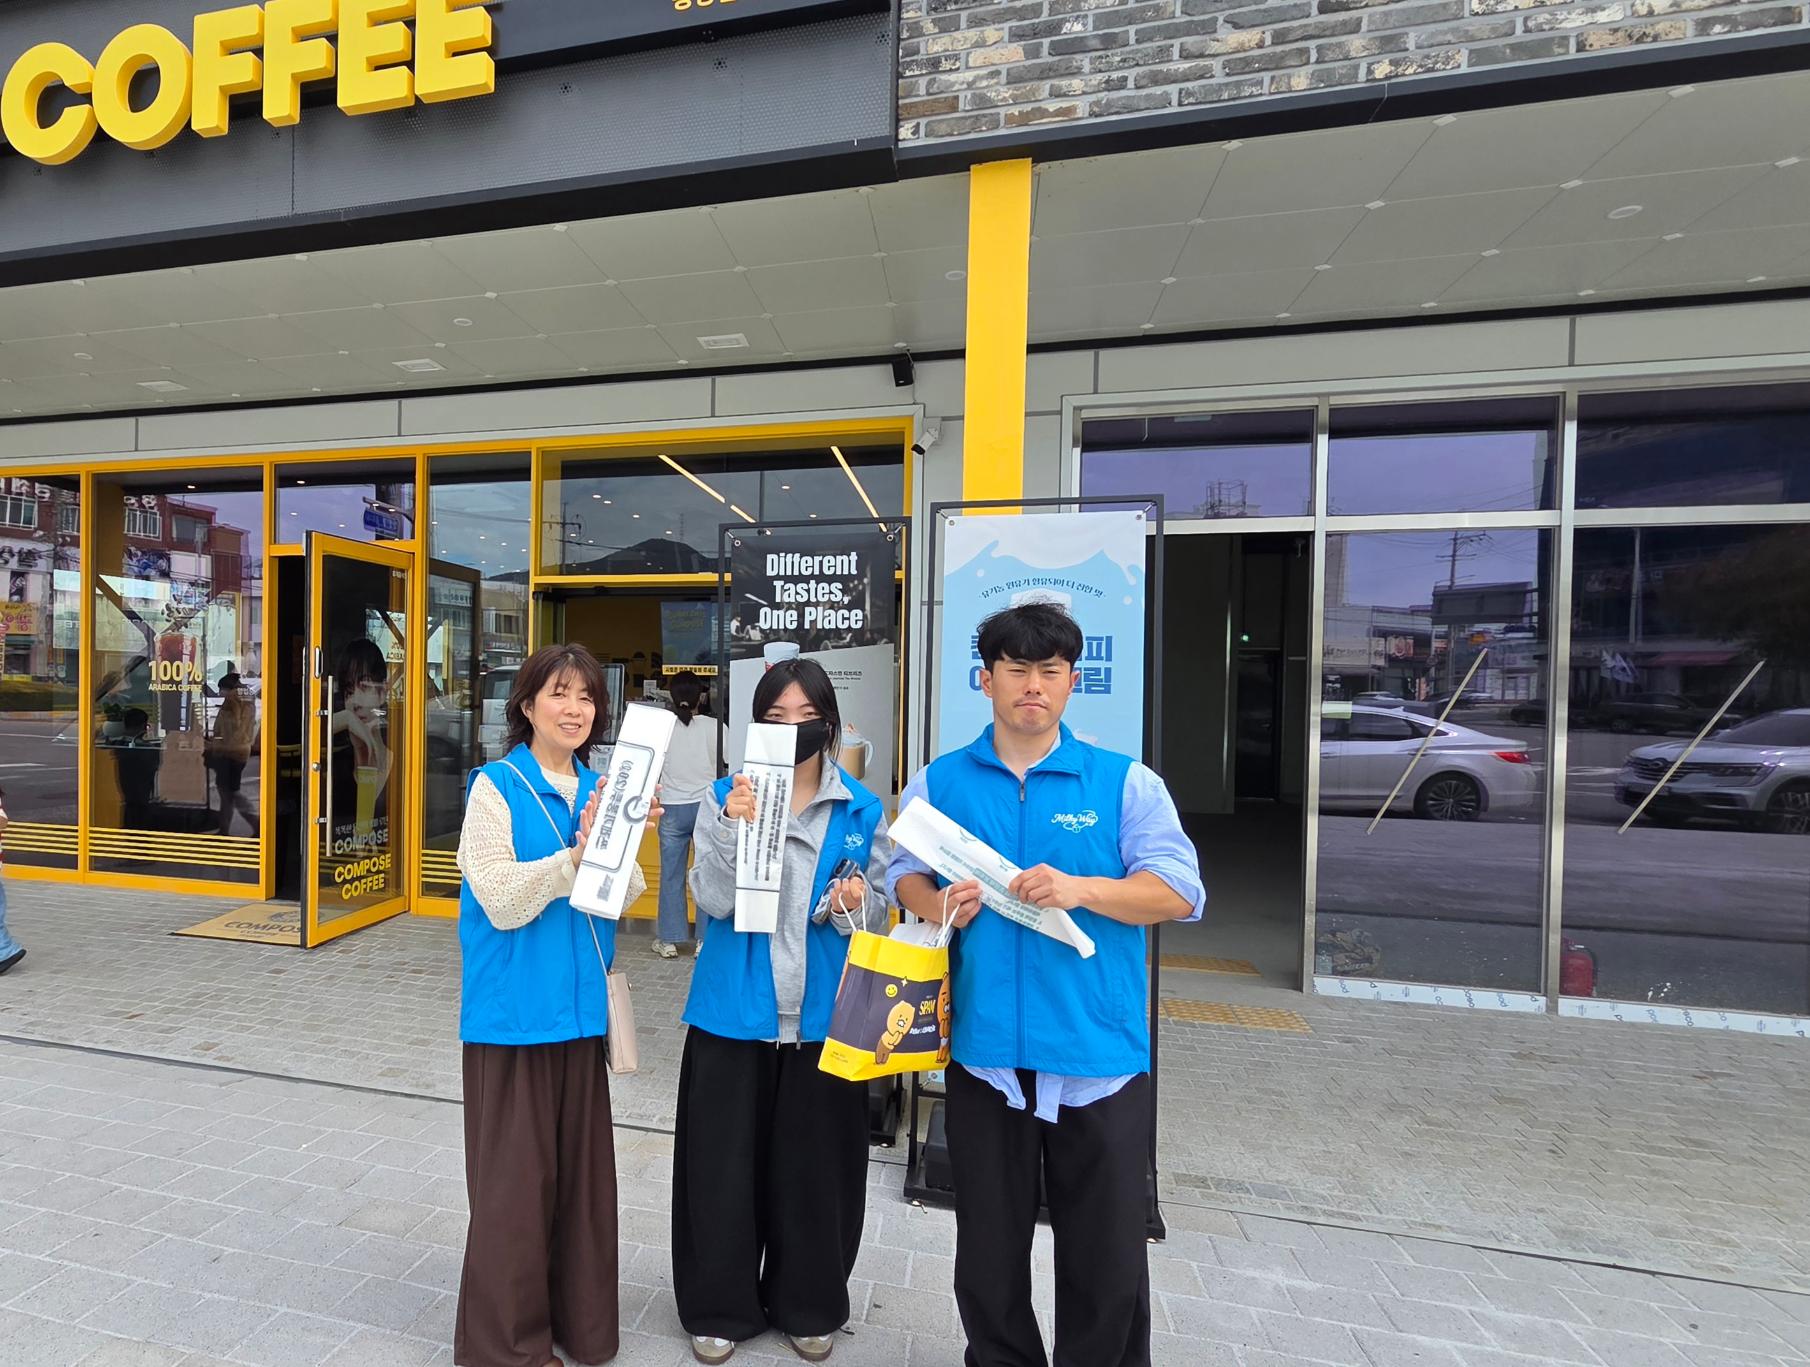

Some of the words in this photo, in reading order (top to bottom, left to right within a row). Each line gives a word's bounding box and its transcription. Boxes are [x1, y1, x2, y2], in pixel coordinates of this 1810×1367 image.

[1, 0, 496, 165] COFFEE
[766, 552, 858, 576] Different
[773, 580, 849, 604] Tastes,
[760, 607, 798, 629] One
[804, 607, 863, 629] Place
[148, 660, 203, 682] 100%
[148, 683, 177, 691] ARABICA
[179, 683, 203, 692] COFFEE
[1051, 813, 1077, 825] Milky
[335, 829, 388, 854] COMPOSE
[335, 854, 392, 883] COMPOSE
[342, 873, 385, 900] COFFEE
[224, 921, 302, 932] COMPOS
